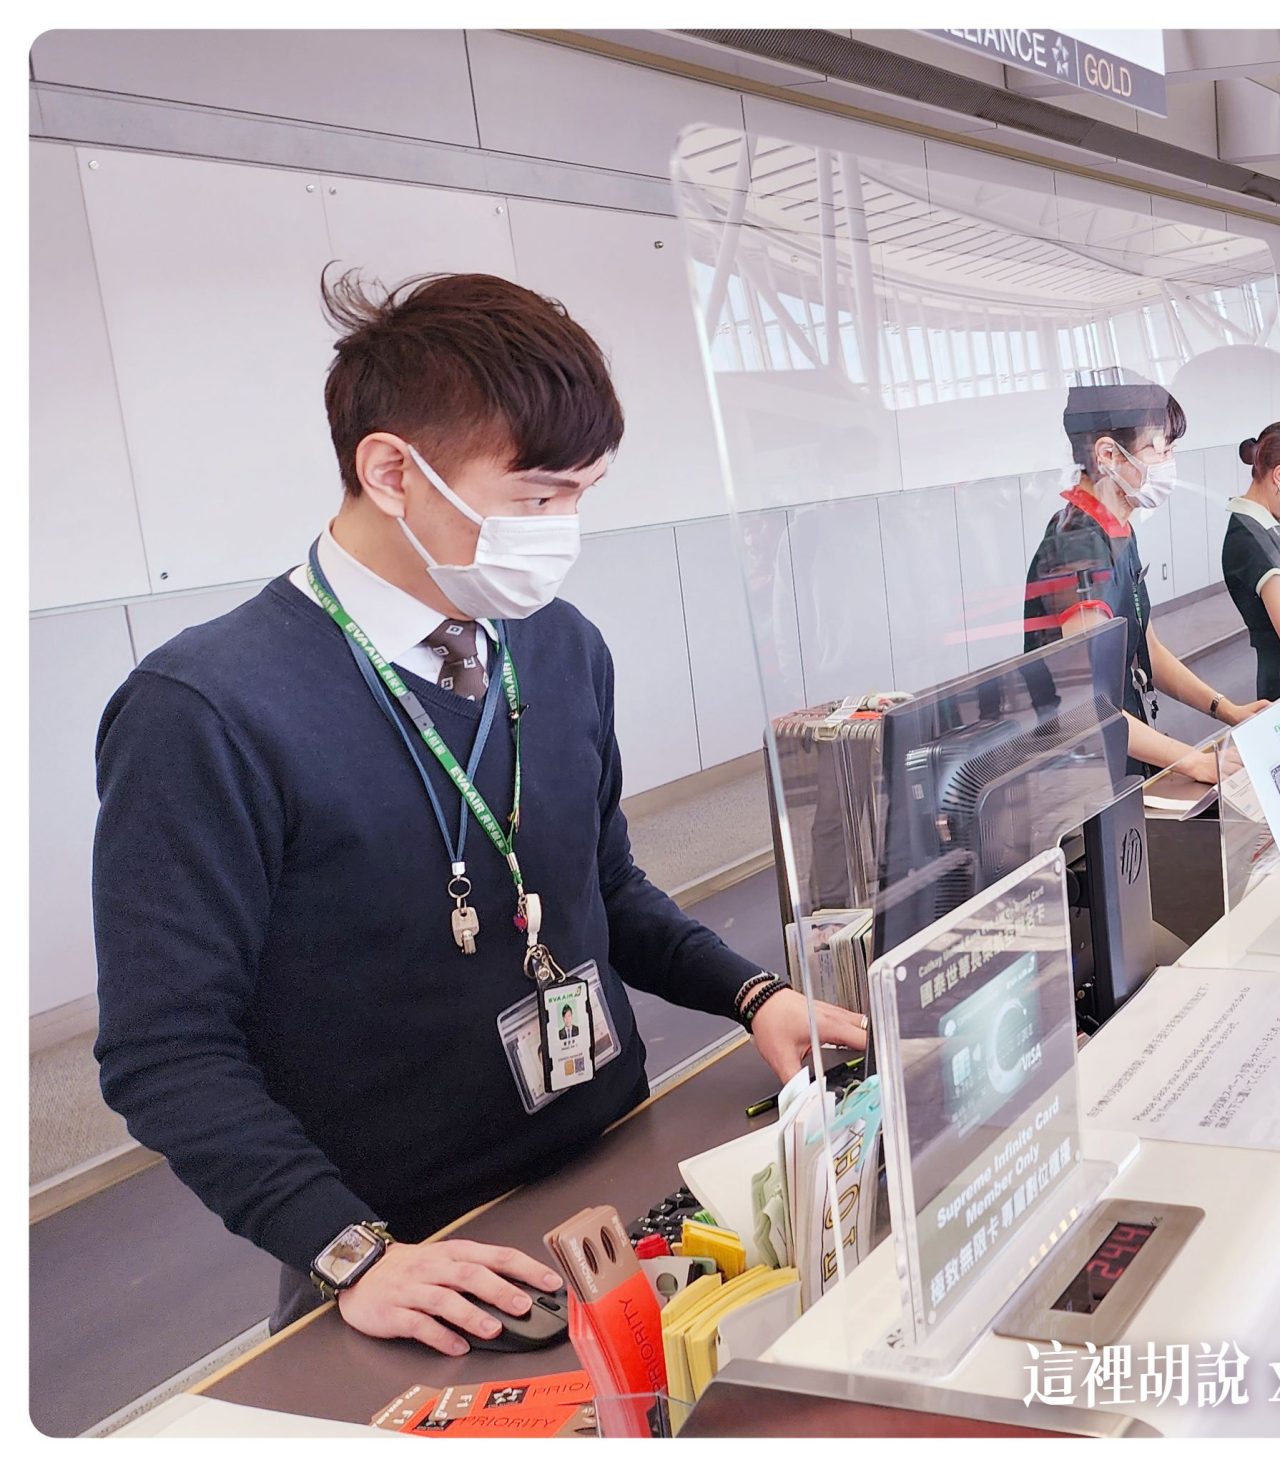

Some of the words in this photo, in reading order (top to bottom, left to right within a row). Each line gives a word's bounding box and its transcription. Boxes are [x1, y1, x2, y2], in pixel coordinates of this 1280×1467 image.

[1084, 53, 1132, 97] GOLD
[1021, 1044, 1042, 1071] VISA
[936, 1167, 992, 1229] Supreme
[993, 1125, 1033, 1171] Infinite
[1034, 1096, 1060, 1130] Card
[965, 1174, 1013, 1229] Member
[1015, 1142, 1041, 1177] Only
[618, 1299, 669, 1394] PRIORITY
[458, 1415, 557, 1430] PRIORITY
